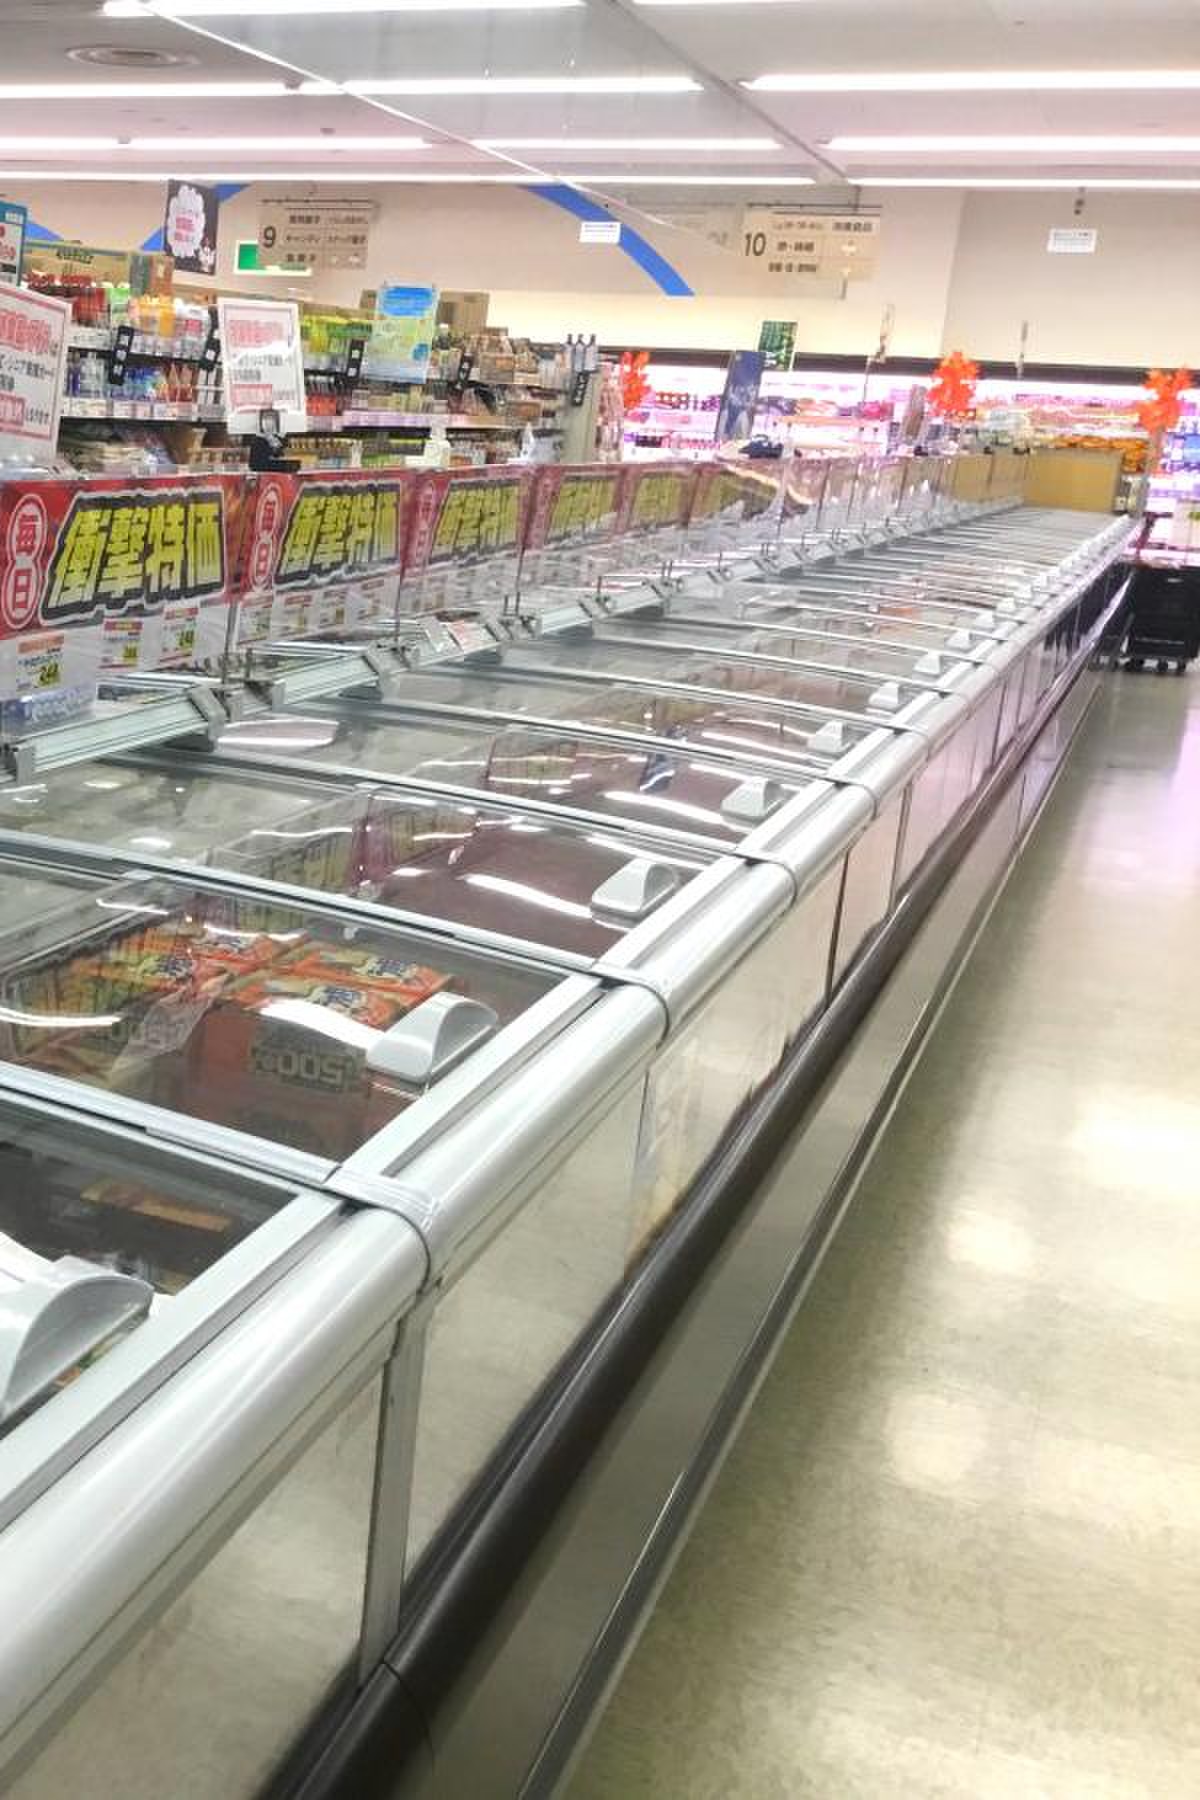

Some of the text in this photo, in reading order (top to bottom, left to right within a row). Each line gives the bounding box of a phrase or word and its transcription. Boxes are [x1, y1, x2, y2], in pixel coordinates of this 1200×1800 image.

[263, 225, 277, 249] 9
[745, 231, 767, 257] 10
[11, 513, 43, 599] 毎日
[43, 502, 223, 609] 衝撃特価
[279, 491, 399, 576] 衝撃特価
